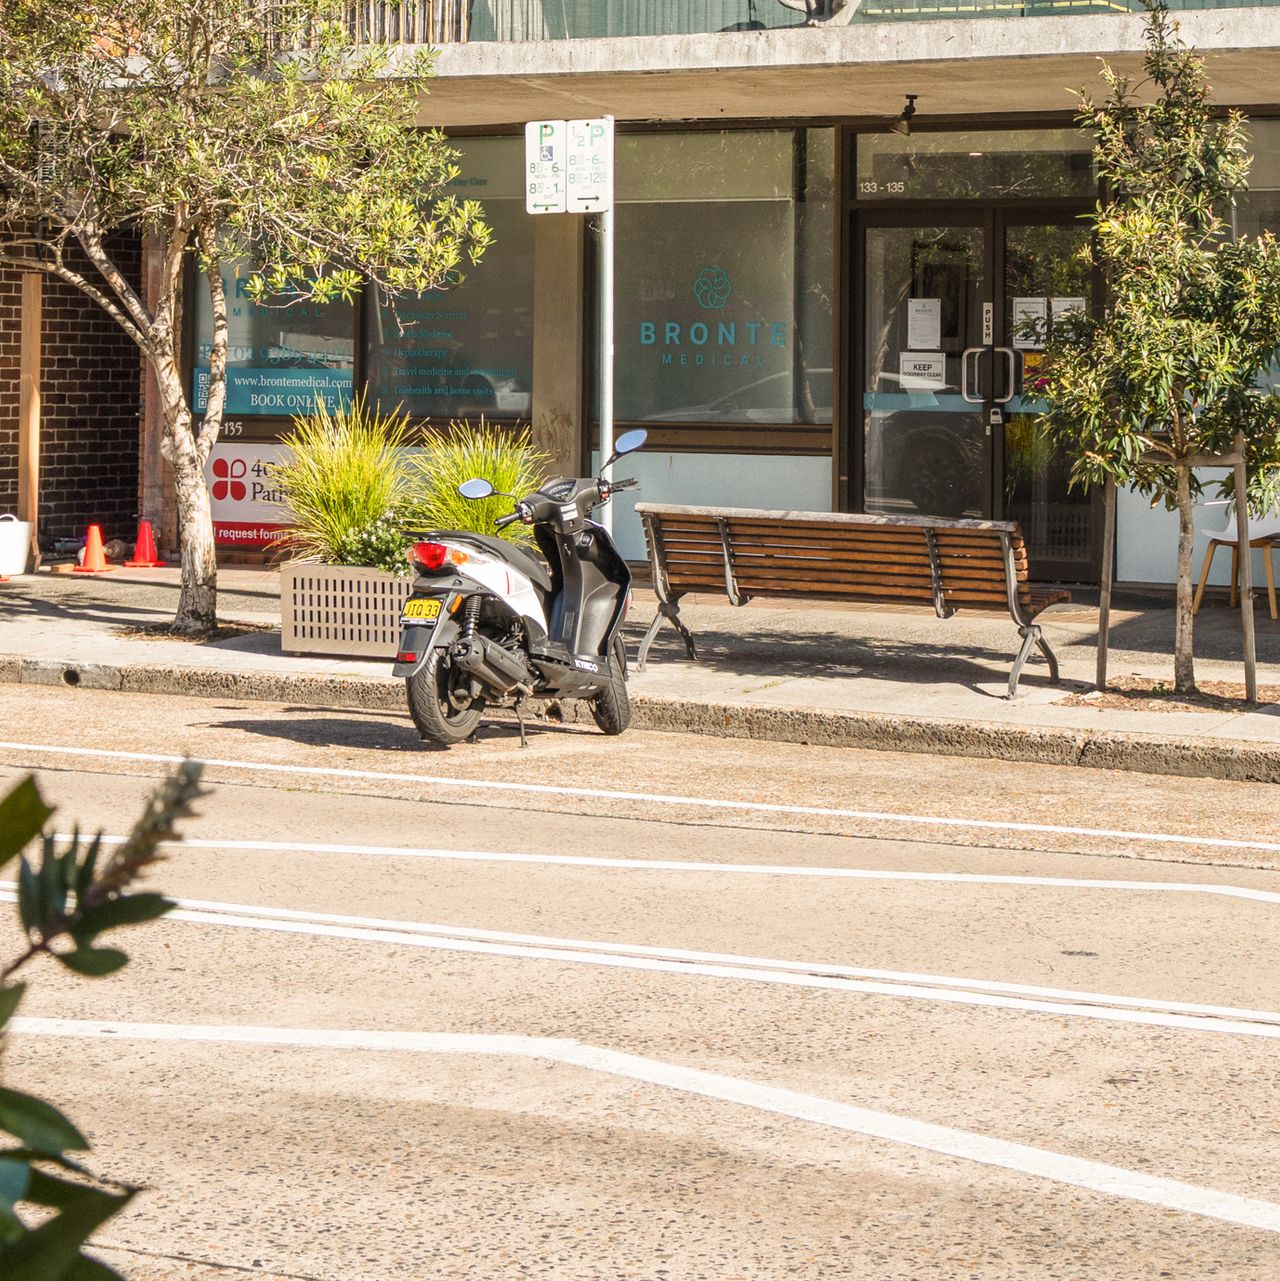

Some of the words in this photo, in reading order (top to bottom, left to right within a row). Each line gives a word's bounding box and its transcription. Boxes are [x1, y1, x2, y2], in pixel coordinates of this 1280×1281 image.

[539, 124, 554, 145] P
[590, 124, 604, 146] P
[859, 182, 878, 193] 133
[886, 181, 905, 193] 135
[232, 307, 321, 317] MEDICAL
[639, 321, 785, 346] BRONTE
[394, 348, 449, 358] Hypnotherapy
[662, 353, 764, 366] MEDICAL
[394, 367, 417, 376] Travel
[419, 367, 453, 376] medicine
[913, 363, 933, 371] KEEP
[234, 376, 352, 388] www.brontemedical.com
[394, 386, 433, 395] Telehealth
[434, 386, 449, 395] and
[450, 386, 471, 395] home
[251, 394, 284, 407] BOOK
[218, 529, 256, 540] request
